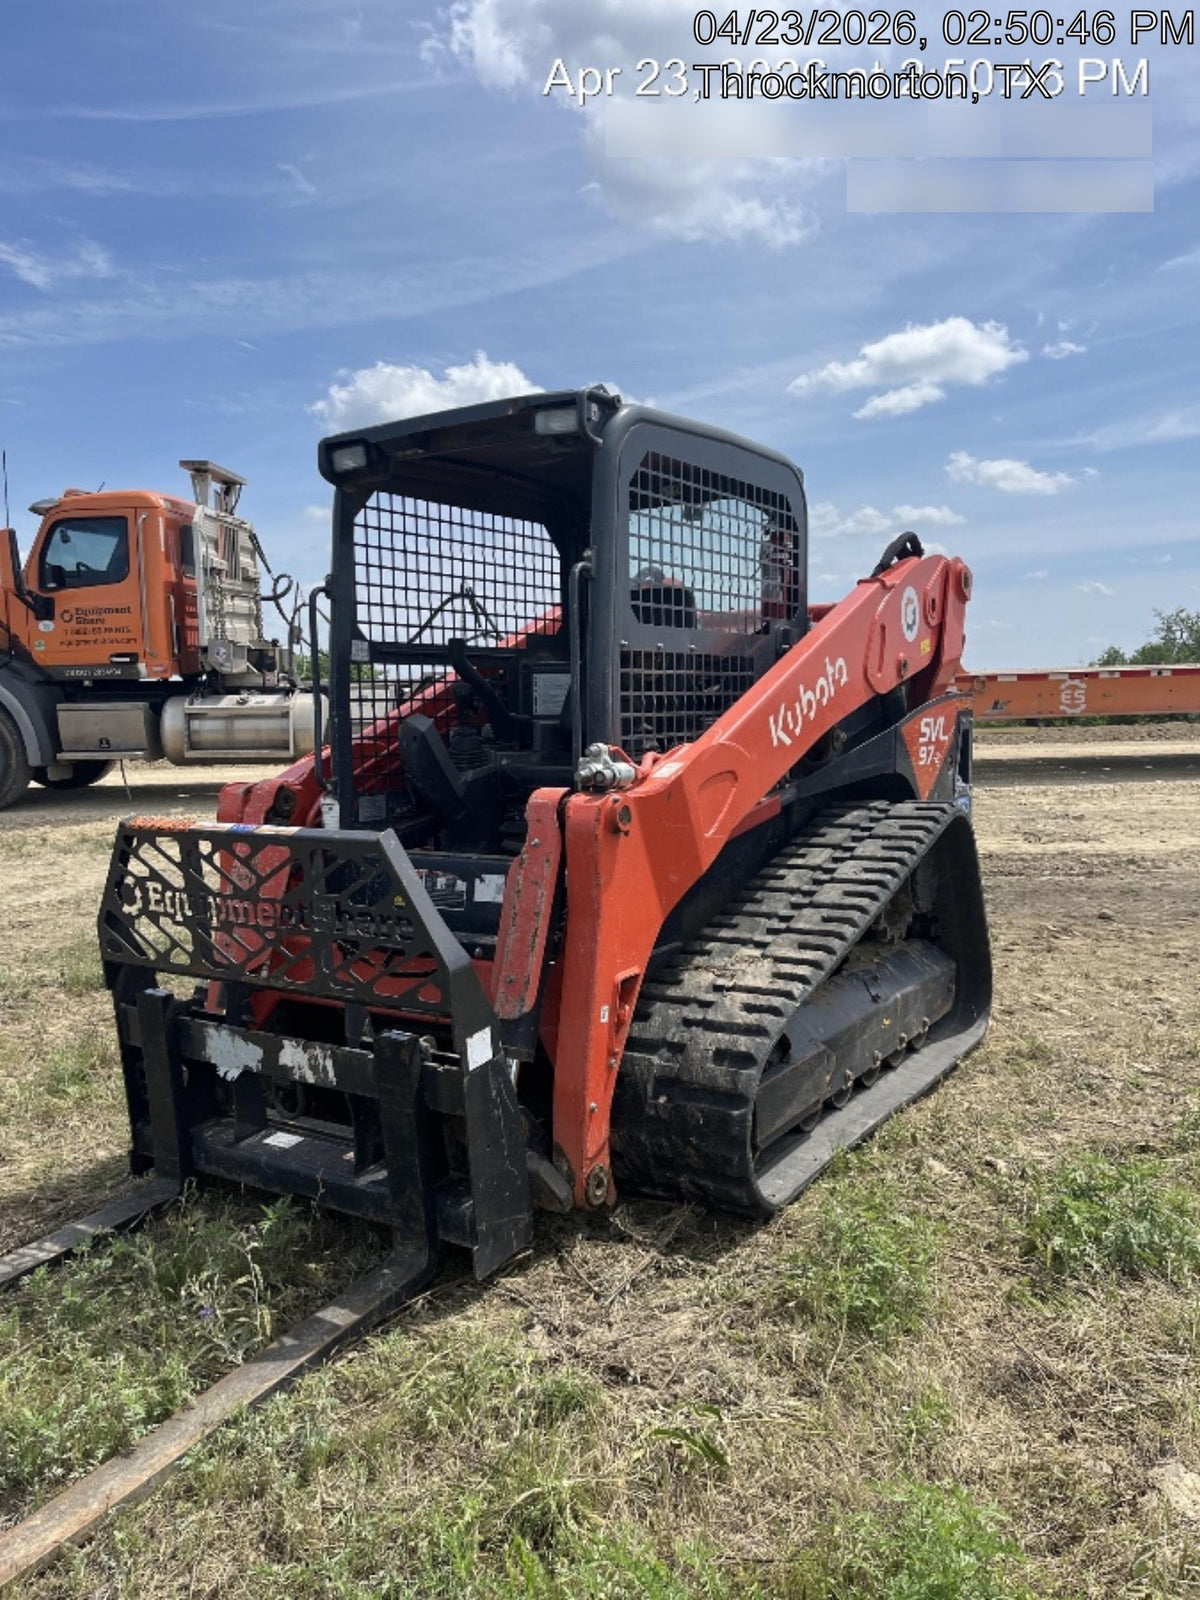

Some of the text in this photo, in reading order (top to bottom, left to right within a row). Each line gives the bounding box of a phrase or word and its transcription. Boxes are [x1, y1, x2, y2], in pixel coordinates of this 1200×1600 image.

[75, 606, 131, 617] Equipment
[75, 616, 105, 625] Share
[768, 656, 848, 747] Kubota
[1061, 689, 1085, 704] ES
[918, 715, 948, 743] SVL
